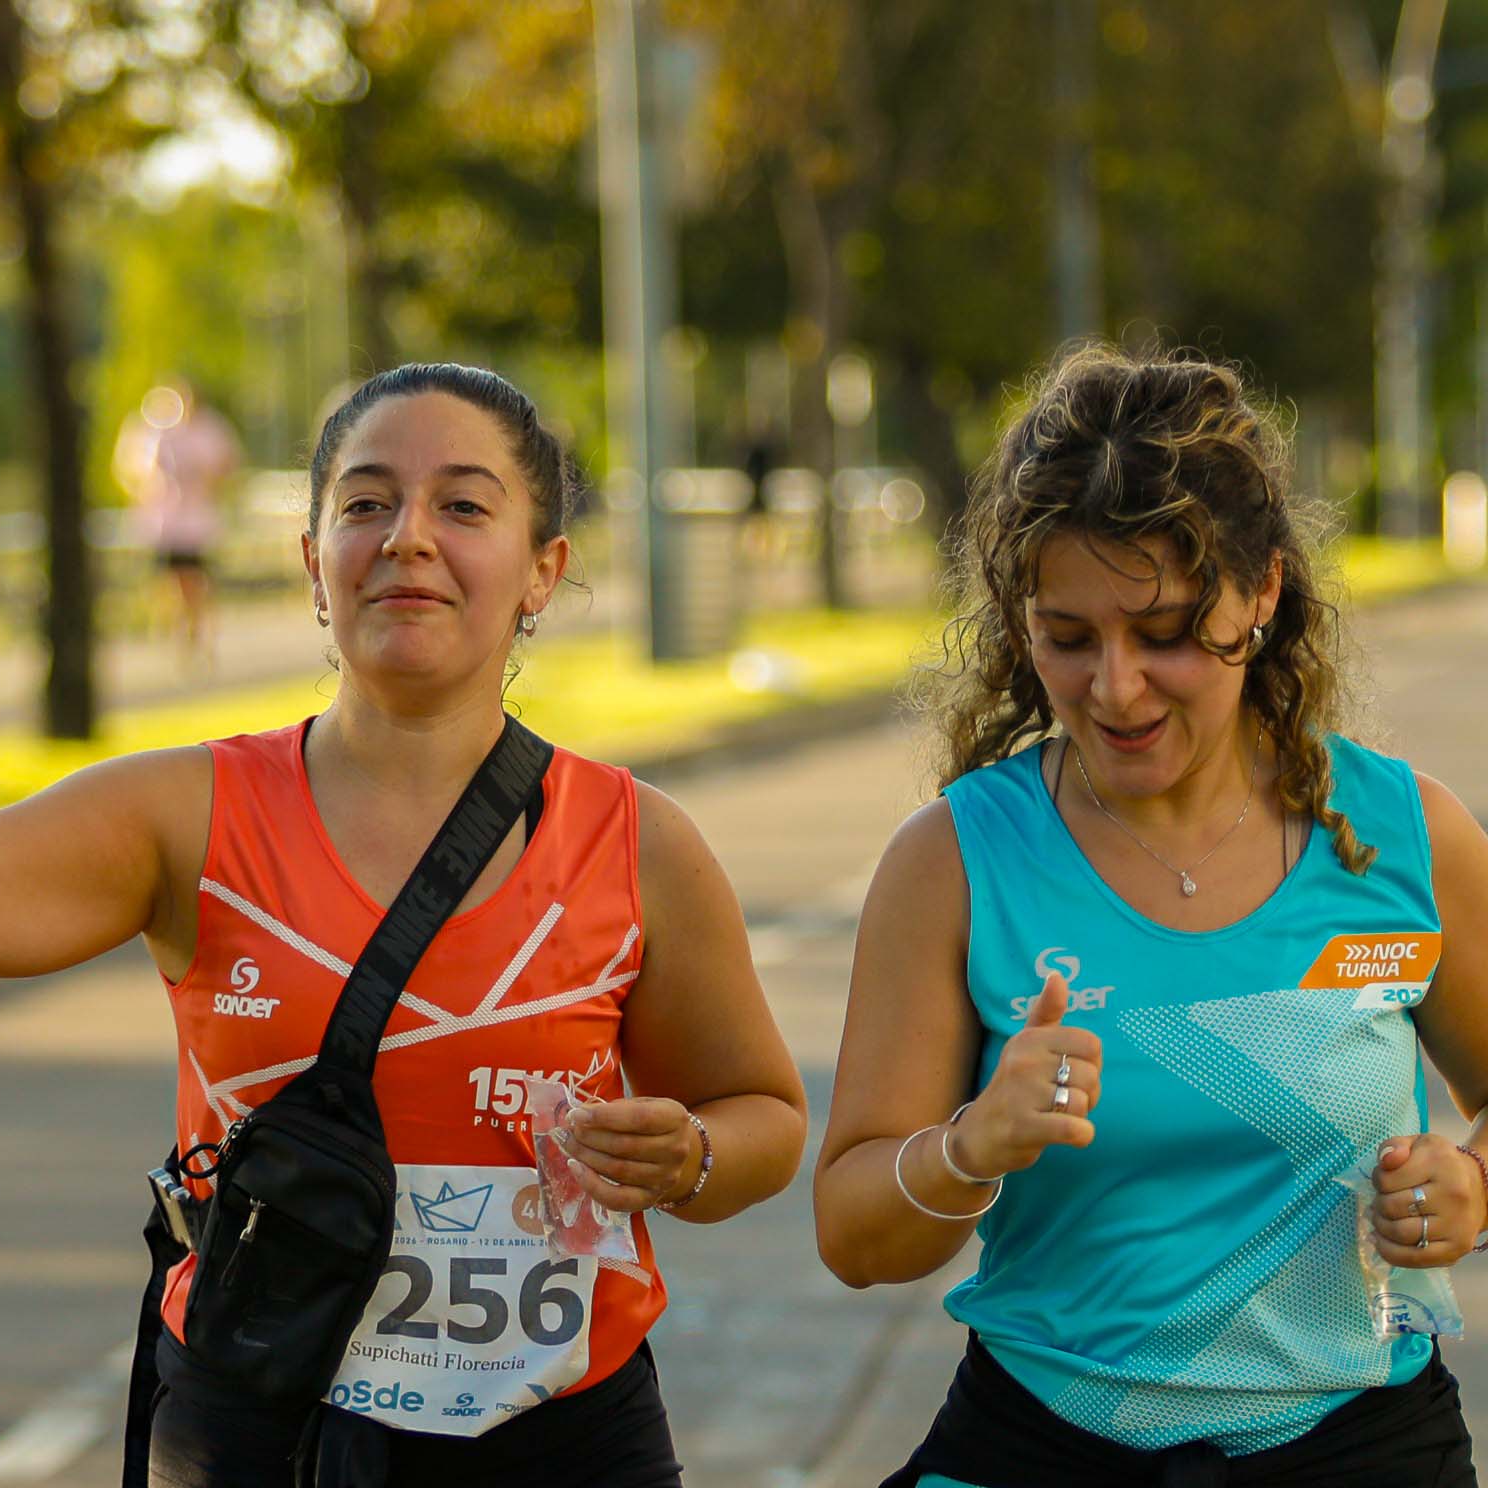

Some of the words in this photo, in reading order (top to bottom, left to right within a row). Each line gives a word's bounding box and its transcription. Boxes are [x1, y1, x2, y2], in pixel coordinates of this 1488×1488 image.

[1372, 941, 1420, 961] NOC
[1335, 961, 1400, 978] TURNA
[427, 1237, 468, 1246] ROSARIO
[479, 1238, 490, 1247] 12
[493, 1238, 505, 1247] DE
[508, 1238, 536, 1247] ABRIL
[376, 1255, 585, 1346] 256
[350, 1341, 438, 1368] Supichatti
[444, 1353, 525, 1371] Florencia
[330, 1379, 425, 1413] osde
